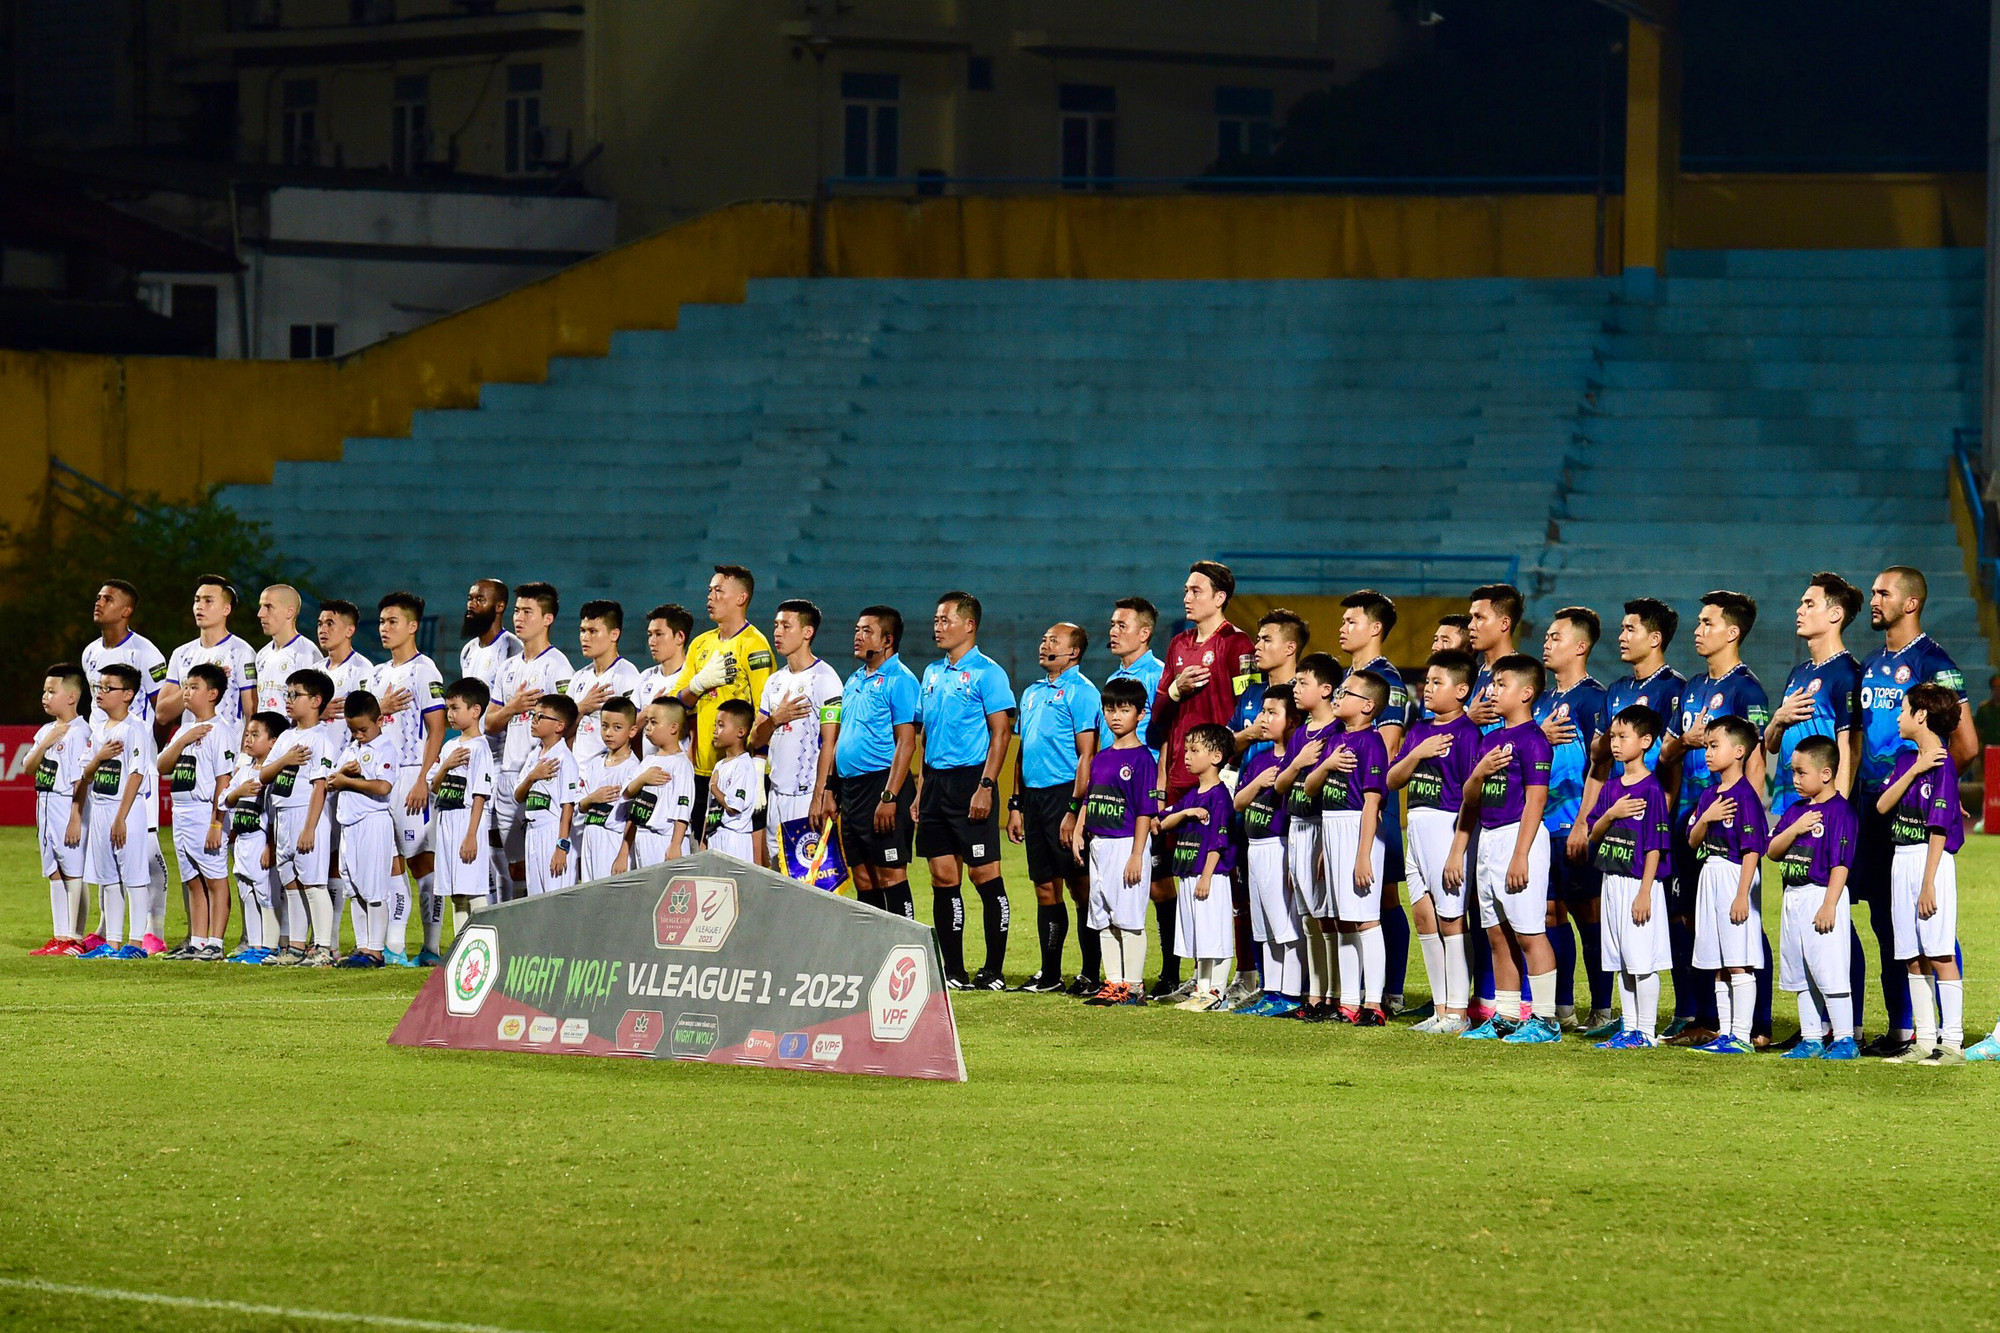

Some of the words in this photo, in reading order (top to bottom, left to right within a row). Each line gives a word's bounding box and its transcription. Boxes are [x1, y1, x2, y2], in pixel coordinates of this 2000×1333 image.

[1873, 687, 1904, 700] TOPEN
[1873, 699, 1894, 709] LAND
[100, 773, 120, 784] WOLF
[1417, 781, 1442, 797] WOLF
[1485, 783, 1507, 797] WOLF
[1098, 802, 1125, 817] WOLF
[1250, 810, 1272, 825] WOLF
[1612, 846, 1634, 861] WOLF
[951, 897, 963, 931] JOGARBOLA
[996, 895, 1010, 932] JOGARBOLA
[698, 935, 713, 943] 2023
[502, 953, 565, 1007] NIGHT
[562, 957, 622, 1011] WOLF
[789, 973, 863, 1008] 2023
[883, 1008, 909, 1024] VPF
[675, 1029, 695, 1043] NIGHT
[695, 1031, 715, 1045] WOLF
[755, 1038, 763, 1047] FPT
[825, 1041, 841, 1051] VPF
